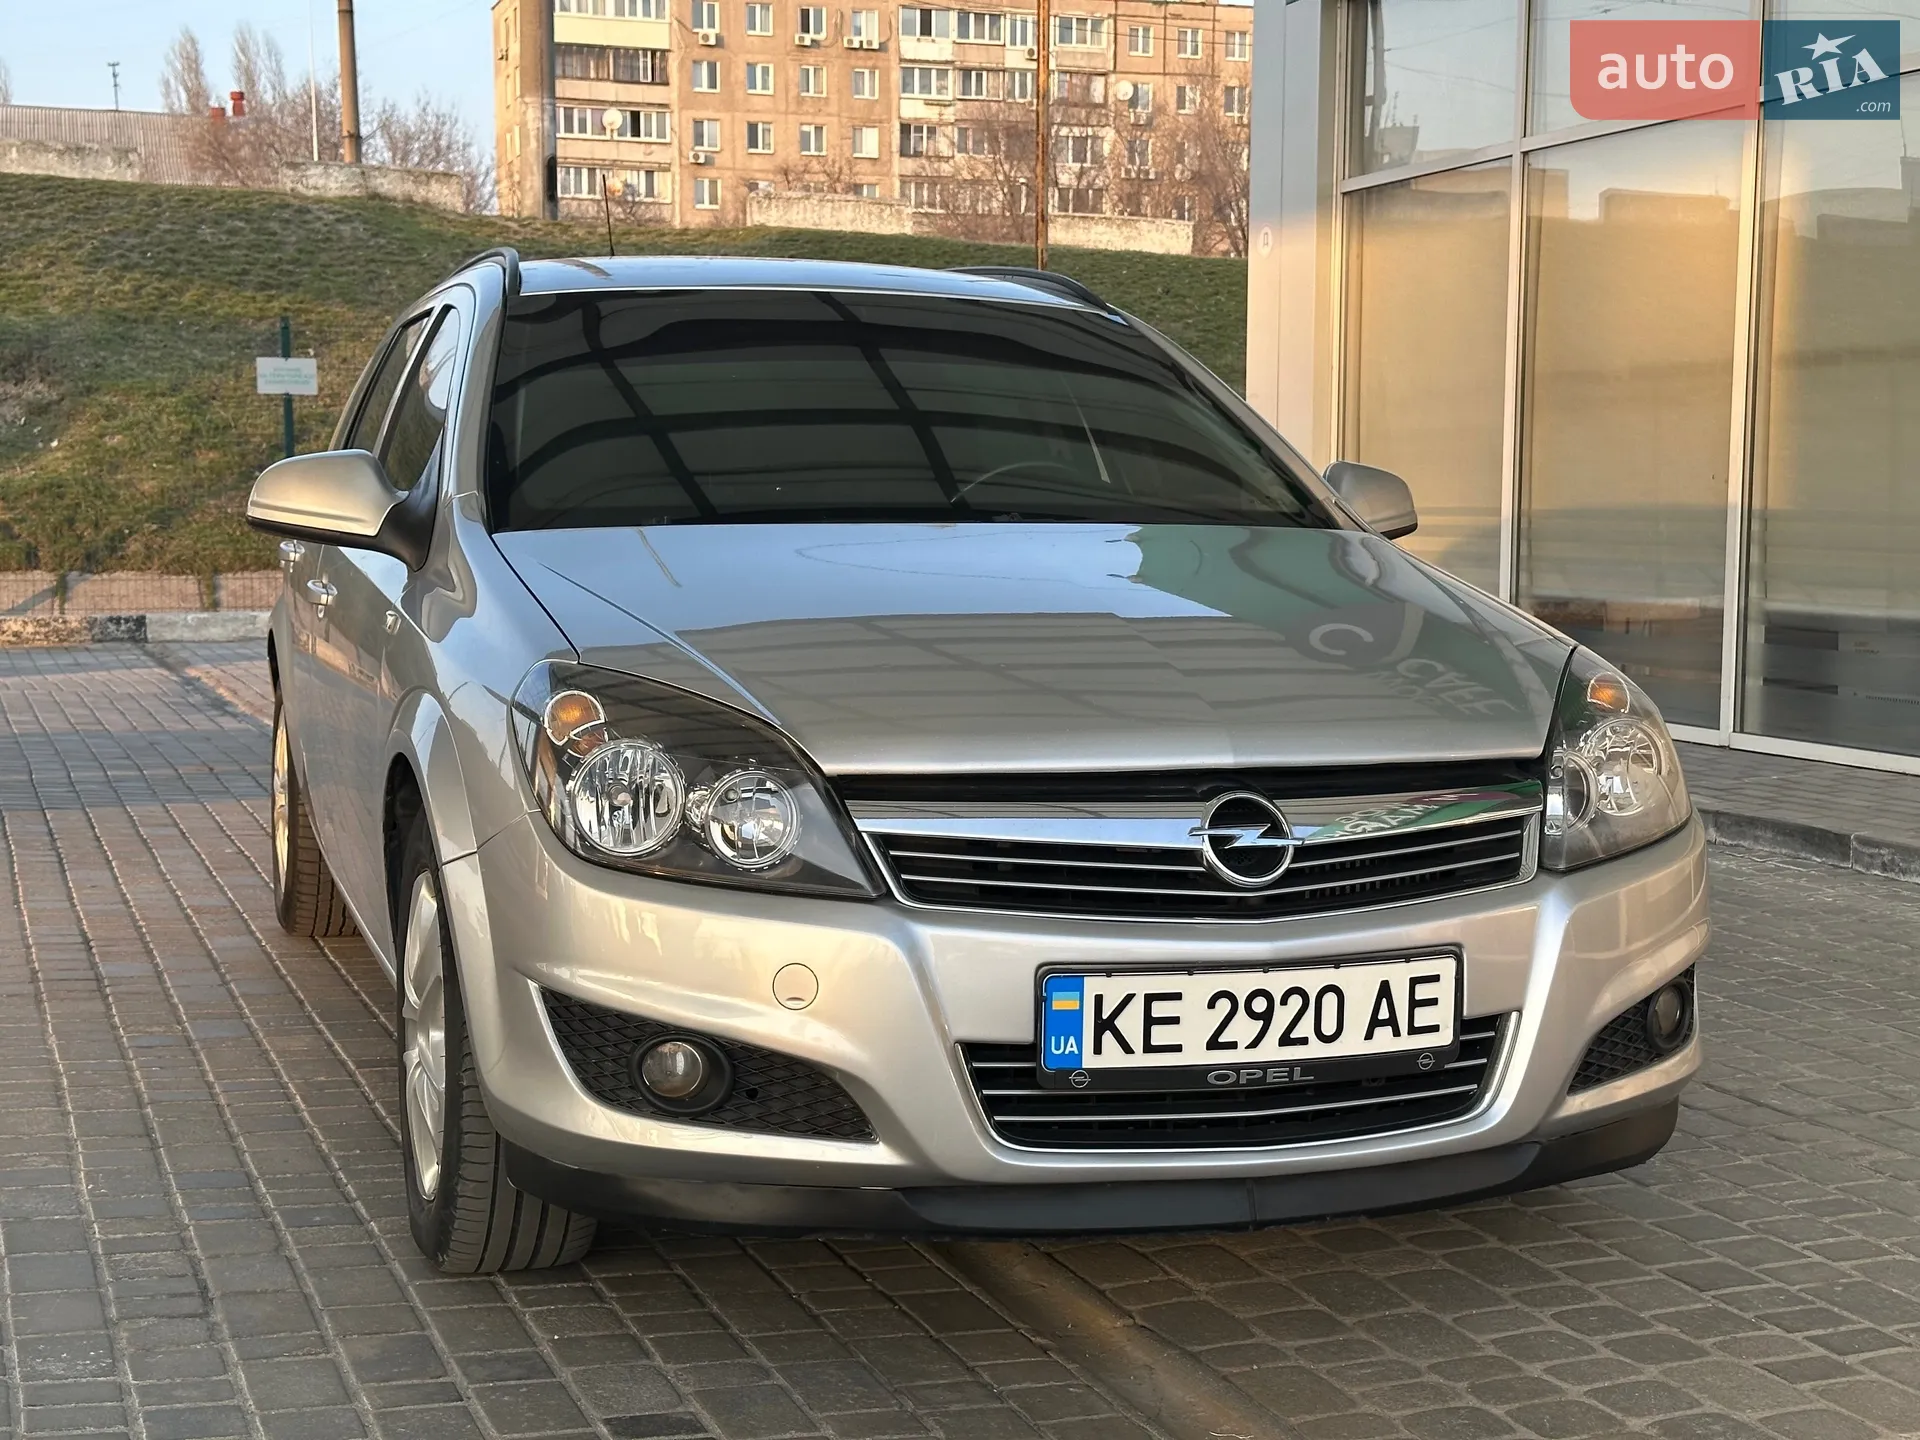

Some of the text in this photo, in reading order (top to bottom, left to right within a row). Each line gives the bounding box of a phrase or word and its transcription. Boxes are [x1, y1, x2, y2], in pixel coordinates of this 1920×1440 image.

[1092, 973, 1441, 1056] KE 2920 AE
[1050, 1035, 1079, 1055] UA
[1206, 1066, 1315, 1086] OPEL
